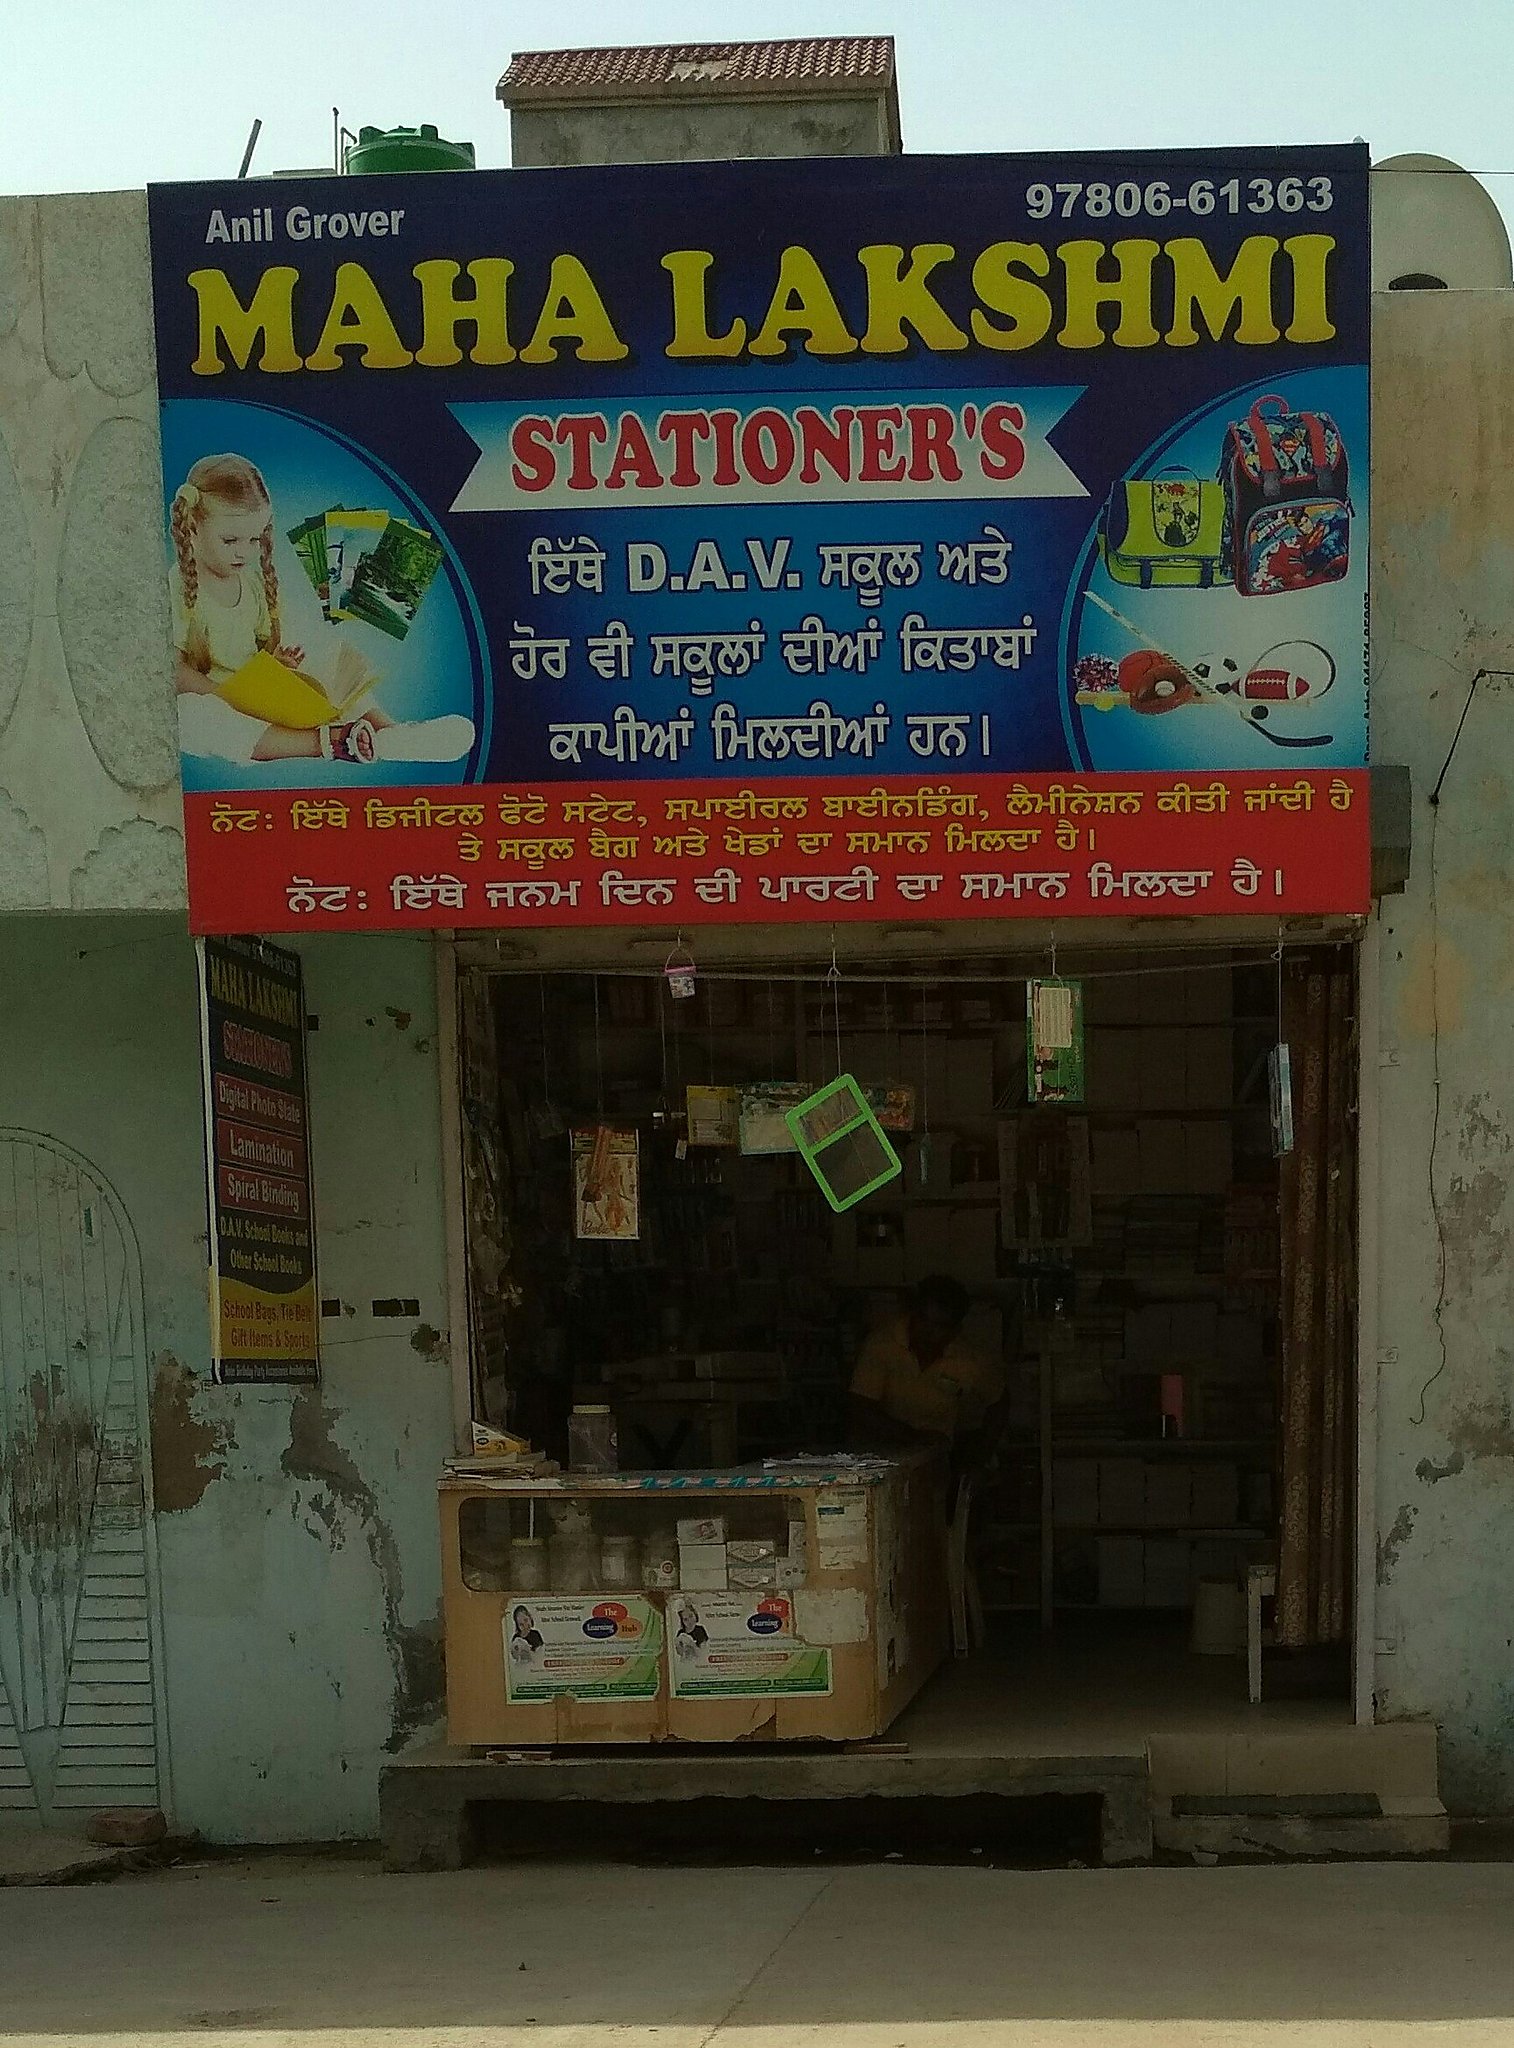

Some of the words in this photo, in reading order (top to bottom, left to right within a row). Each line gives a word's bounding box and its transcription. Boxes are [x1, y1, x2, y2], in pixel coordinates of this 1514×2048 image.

[1026, 176, 1334, 220] 97806-61363
[205, 208, 273, 243] Anil
[286, 205, 405, 241] Grover
[187, 253, 629, 376] MAHA
[660, 234, 1336, 358] LAKSHMI
[510, 401, 1026, 493] STATIONER'S
[528, 536, 606, 594] ਇੱਥੇ
[628, 540, 801, 592] D.A.V.
[819, 543, 922, 606] ਸਕੂਲ
[938, 526, 1012, 585] ਅਤੇ
[509, 620, 570, 679] ਹੋਰ
[587, 621, 634, 678] ਵੀ
[651, 620, 765, 695] ਸਕੂਲਾਂ
[782, 616, 883, 673] ਦੀਆਂ
[900, 614, 1037, 671] ਕਿਤਾਬਾਂ
[549, 706, 694, 763] ਕਾਪੀਆਂ
[712, 702, 889, 760] ਮਿਲਦੀਆਂ
[290, 799, 351, 830] ਇੱਥੇ
[364, 797, 485, 829] ਡਿਜੀਟਲ
[498, 793, 549, 825] ਫੋਟੋ
[562, 793, 648, 828] ਸਟੇਟ,
[664, 789, 809, 821] ਸਪਾਈਰਲ
[822, 785, 990, 822] ਬਾਈਨਡਿੰਗ,
[1156, 782, 1231, 814] ਕੀਤੀ
[1243, 780, 1316, 812] ਜਾਂਦੀ
[1328, 779, 1354, 811] ਹੈ
[457, 832, 484, 862] ਤੇ
[497, 838, 575, 871] ਸਕੂਲ
[588, 827, 640, 859] ਬੈਗ
[652, 827, 710, 858] ਅਤੇ
[723, 827, 784, 857] ਖੇਡਾਂ
[796, 832, 834, 855] ਦਾ
[846, 831, 932, 854] ਸਮਾਨ
[945, 822, 1042, 853] ਮਿਲਦਾ
[390, 874, 468, 911] ਇੱਥੇ
[485, 878, 581, 908] ਜਨਮ
[599, 870, 678, 907] ਦਿਨ
[694, 868, 742, 903] ਦੀ
[758, 866, 879, 902] ਪਾਰਟੀ
[896, 874, 943, 902] ਦਾ
[960, 873, 1070, 900] ਸਮਾਨ
[1087, 862, 1213, 898] ਮਿਲਦਾ
[219, 1080, 250, 1111] Digital
[251, 1095, 277, 1118] Photo
[278, 1103, 300, 1125] State
[229, 1129, 295, 1169] Lamination
[227, 1173, 260, 1203] Spiral
[261, 1183, 300, 1213] Binding
[245, 1218, 271, 1242] School
[230, 1248, 251, 1270] Other
[253, 1251, 279, 1273] School
[223, 1299, 254, 1321] School
[281, 1303, 295, 1322] Tie
[231, 1327, 247, 1348] Gift
[248, 1328, 274, 1348] Items
[283, 1330, 311, 1351] Sports
[603, 1608, 618, 1617] The
[751, 1618, 779, 1629] Learning
[768, 1603, 783, 1612] The
[621, 1624, 638, 1633] Hub
